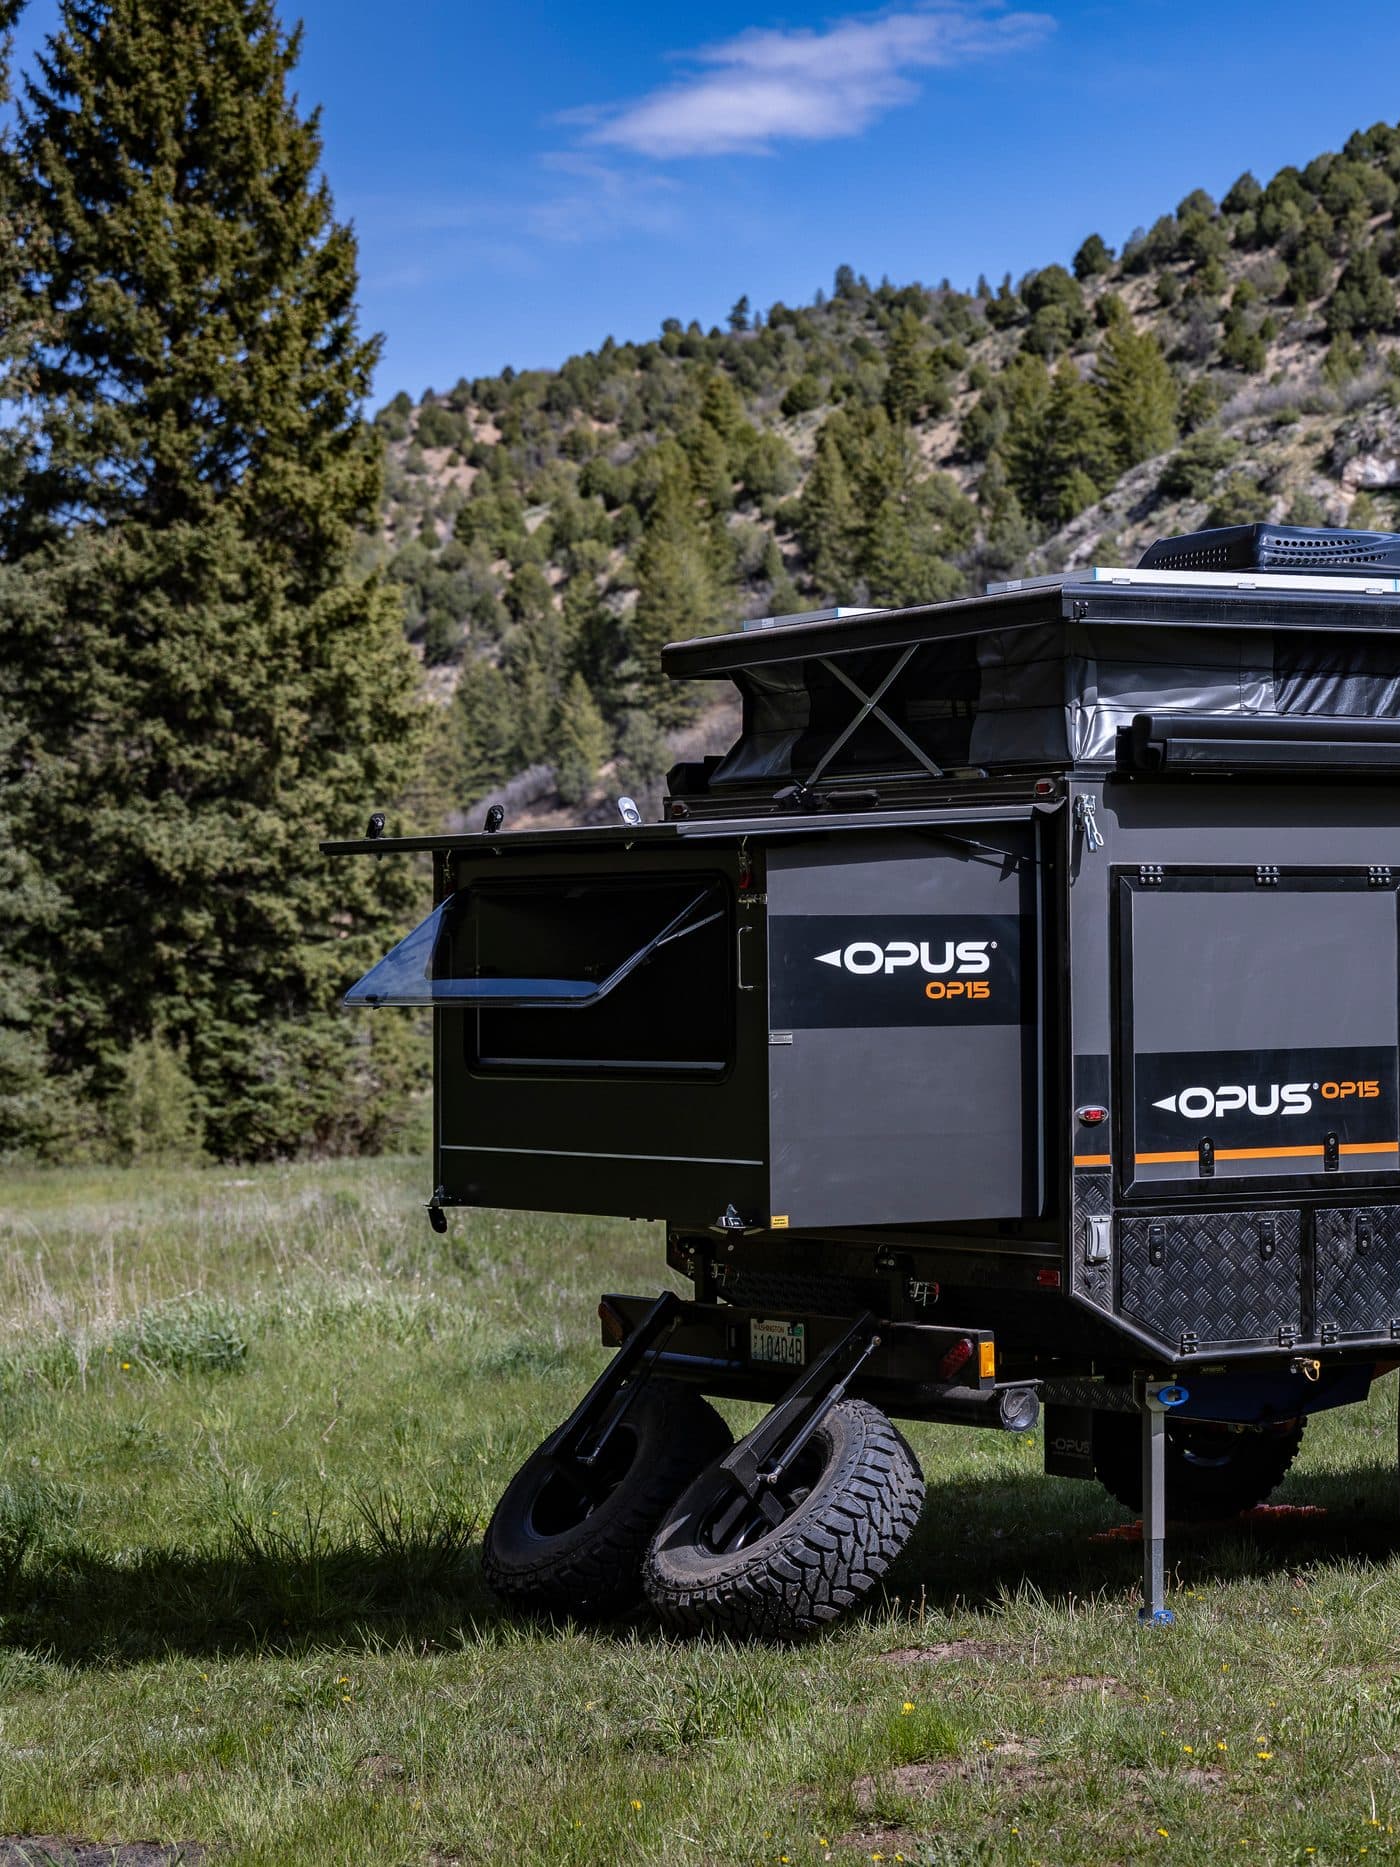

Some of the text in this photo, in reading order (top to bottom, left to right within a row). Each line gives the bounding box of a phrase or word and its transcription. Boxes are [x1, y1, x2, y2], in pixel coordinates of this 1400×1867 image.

[843, 941, 990, 975] OPUS
[925, 981, 991, 999] OP15
[1178, 1080, 1381, 1119] OPUS OP15
